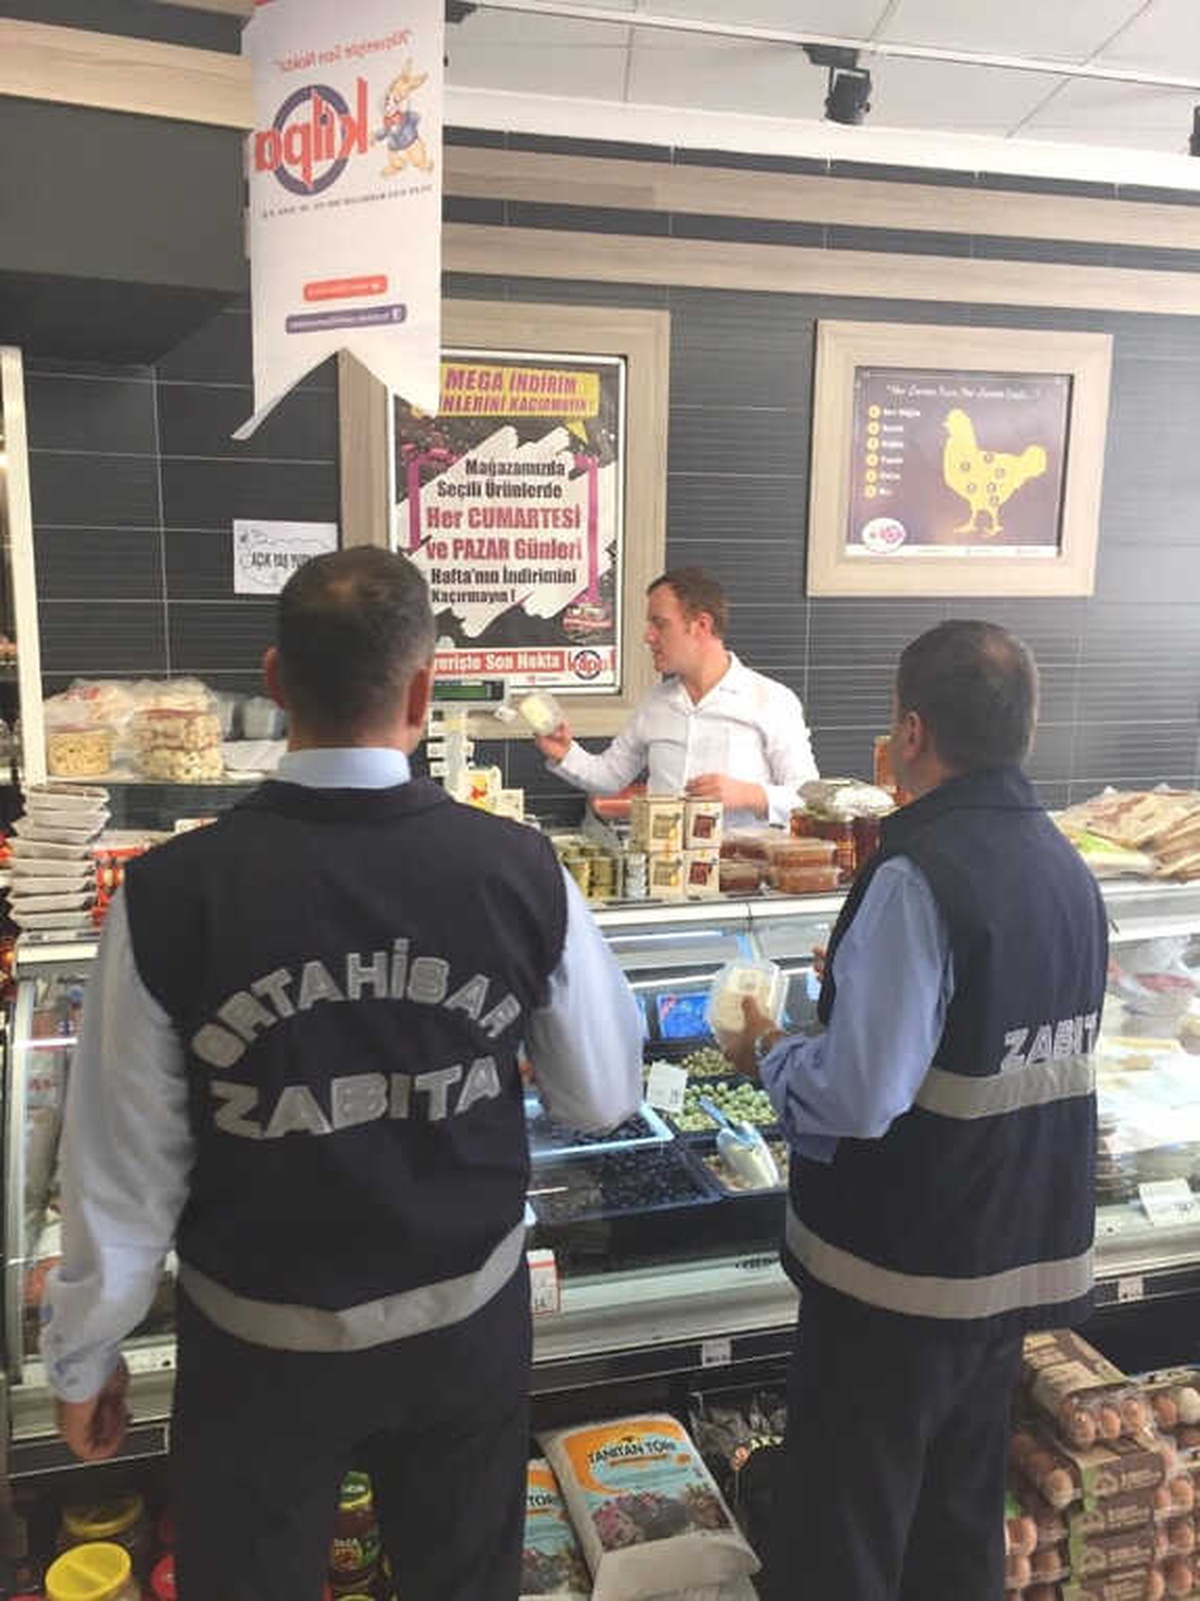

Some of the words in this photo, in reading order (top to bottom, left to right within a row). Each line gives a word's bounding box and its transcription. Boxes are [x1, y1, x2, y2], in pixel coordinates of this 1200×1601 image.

[446, 367, 503, 391] MEGA
[510, 370, 577, 394] İNDİRİM
[442, 395, 506, 412] NLERİNİ
[465, 458, 565, 476] Mağazamızda
[437, 479, 481, 500] Seçili
[485, 479, 562, 499] Ürünlerde
[426, 507, 463, 529] Her
[468, 503, 581, 530] CUMARTESİ
[426, 540, 448, 560] ve
[453, 537, 509, 560] PAZAR
[514, 537, 582, 560] Günleri
[431, 568, 500, 585] Hafta'nın
[502, 565, 577, 585] İndirimini
[431, 589, 509, 605] Kaçırmayın
[485, 653, 513, 671] Son
[1001, 1009, 1099, 1069] ZABIT
[209, 1055, 501, 1140] ZABITA
